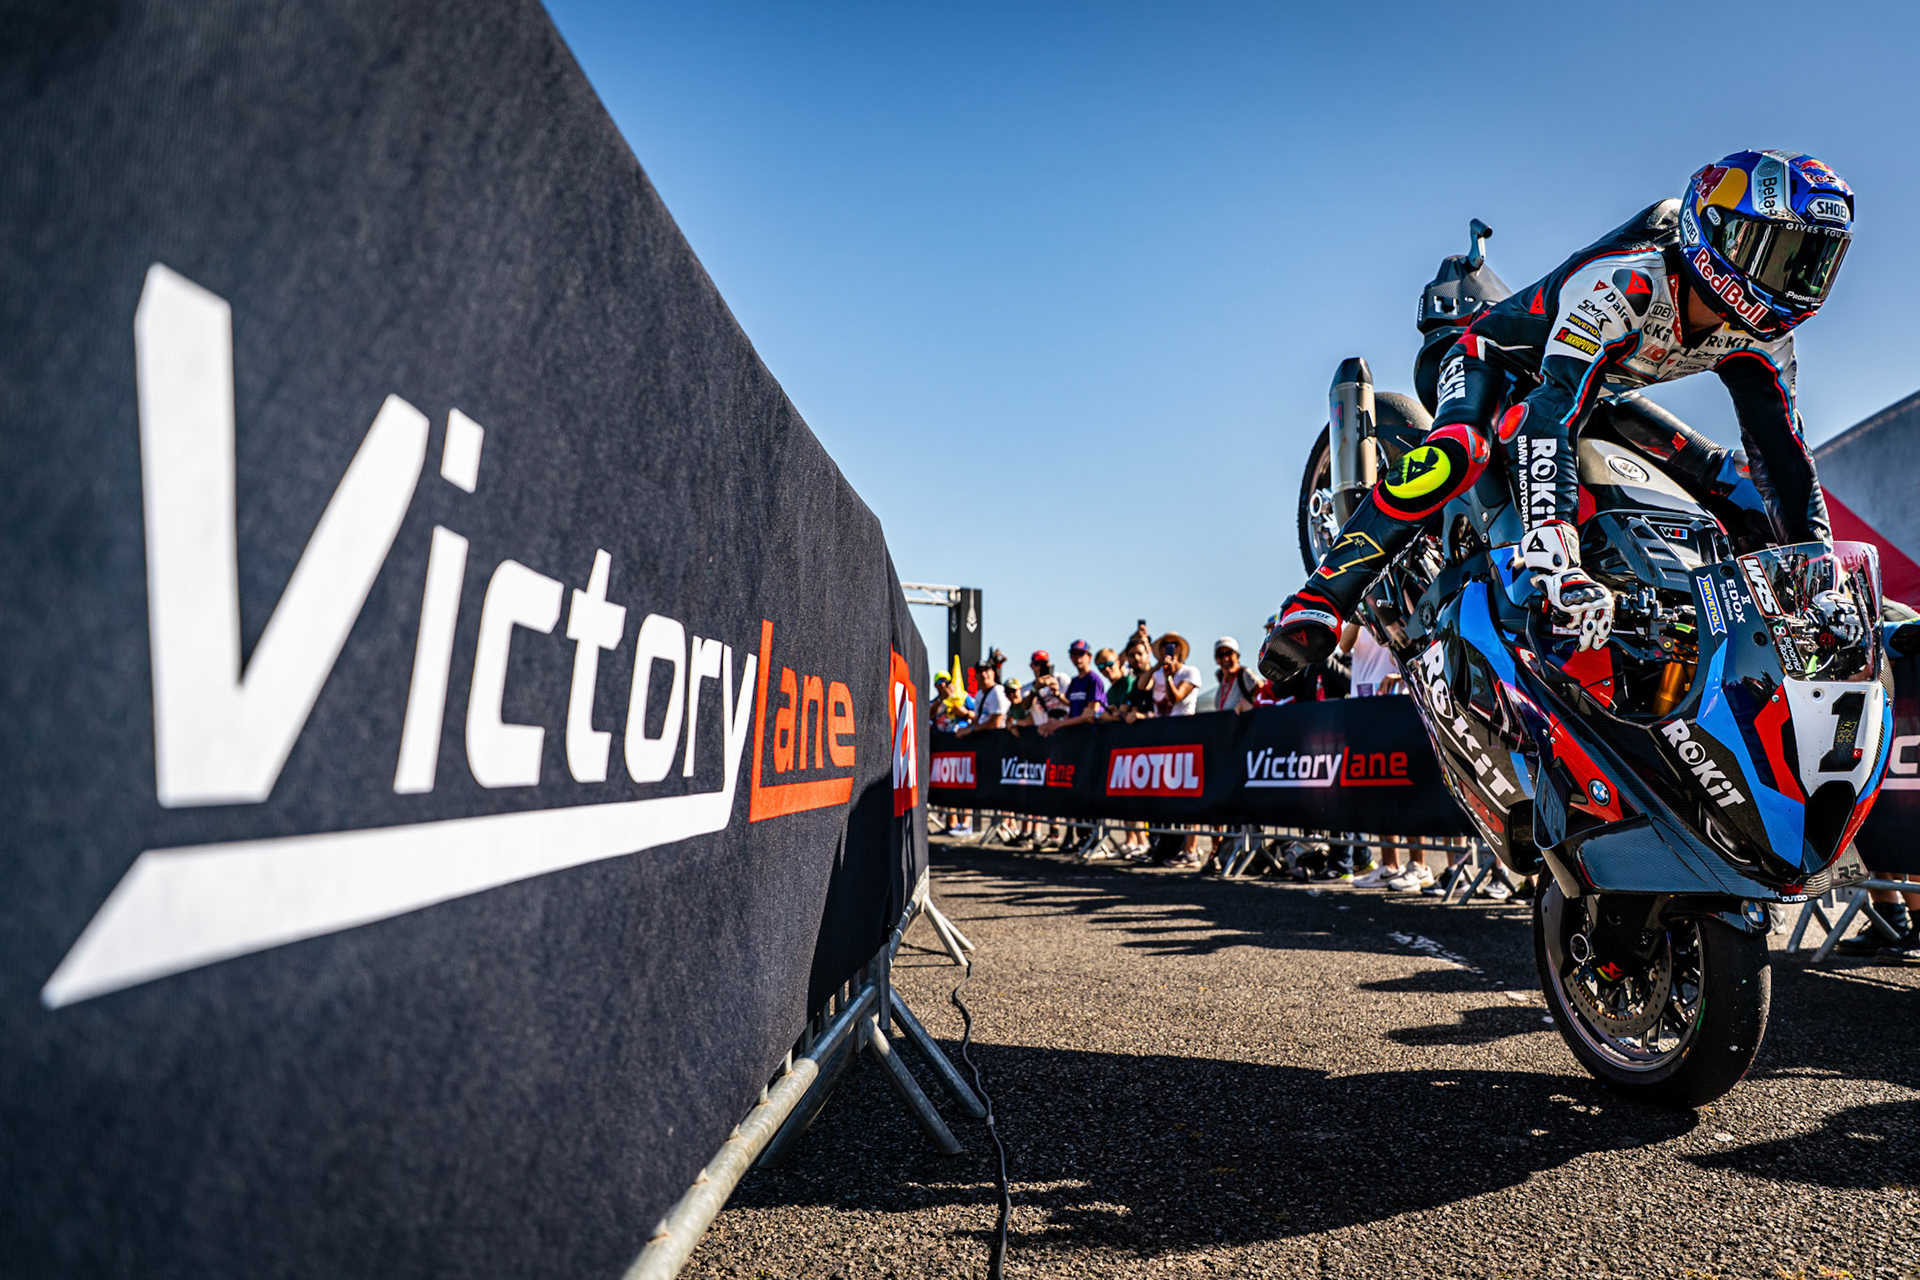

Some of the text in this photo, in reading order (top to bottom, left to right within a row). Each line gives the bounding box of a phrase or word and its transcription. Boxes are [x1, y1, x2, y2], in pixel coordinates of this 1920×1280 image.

[1762, 176, 1778, 209] Beta
[1817, 202, 1847, 219] SHOEI
[1683, 211, 1698, 243] SHOEI
[1785, 222, 1819, 234] GIVES
[1824, 229, 1842, 238] YOU
[1517, 434, 1530, 534] BMW MOTORRA
[1702, 581, 1719, 629] RAVENOL
[1725, 578, 1747, 624] EDOX
[1742, 558, 1781, 615] WRS
[1817, 690, 1867, 773] 1
[930, 756, 975, 784] MOTUL
[1109, 752, 1199, 790] MOTUL
[1661, 718, 1746, 807] ROKiT
[1837, 863, 1862, 879] RR
